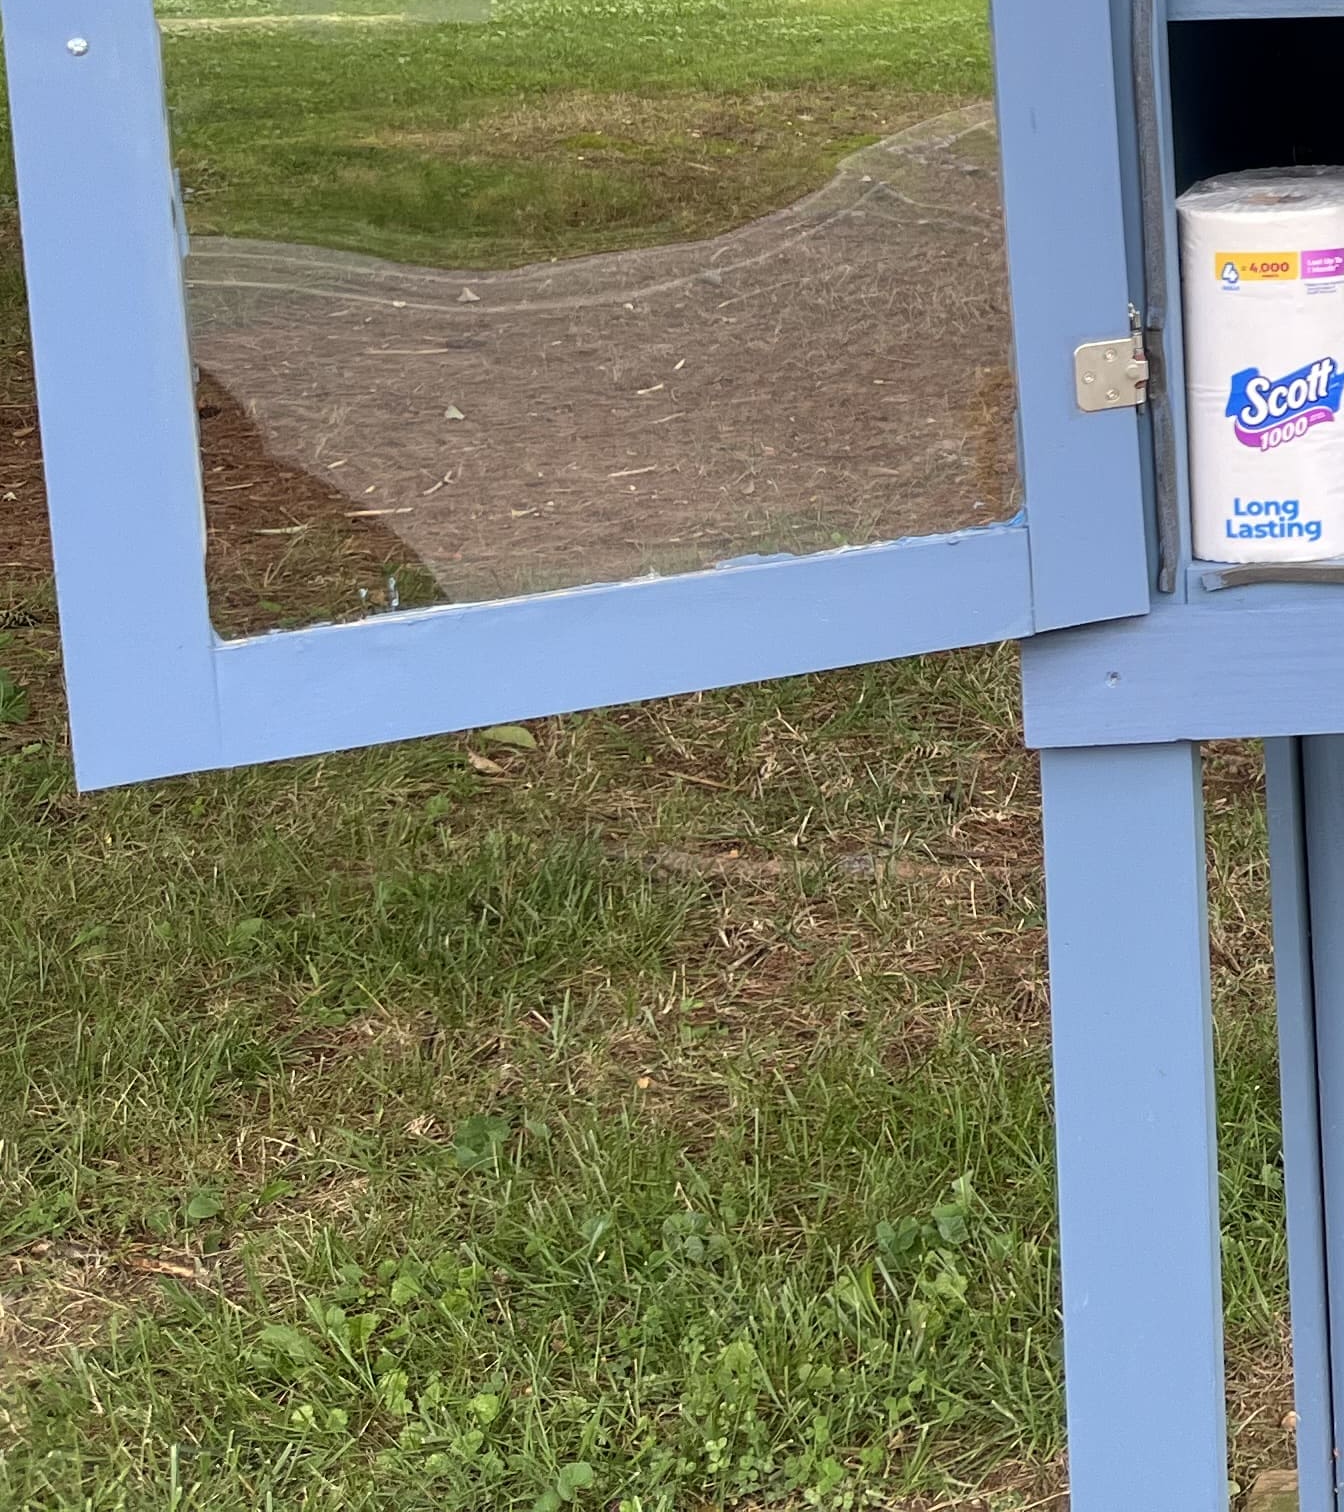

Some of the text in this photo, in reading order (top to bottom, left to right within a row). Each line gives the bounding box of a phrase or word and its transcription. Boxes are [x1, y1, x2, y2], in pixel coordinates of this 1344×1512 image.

[1222, 261, 1239, 284] 4
[1249, 261, 1290, 273] 4,000
[1240, 357, 1334, 426] Scott
[1259, 416, 1309, 452] 1000
[1233, 497, 1300, 521] Long
[1226, 516, 1323, 542] Lasting
